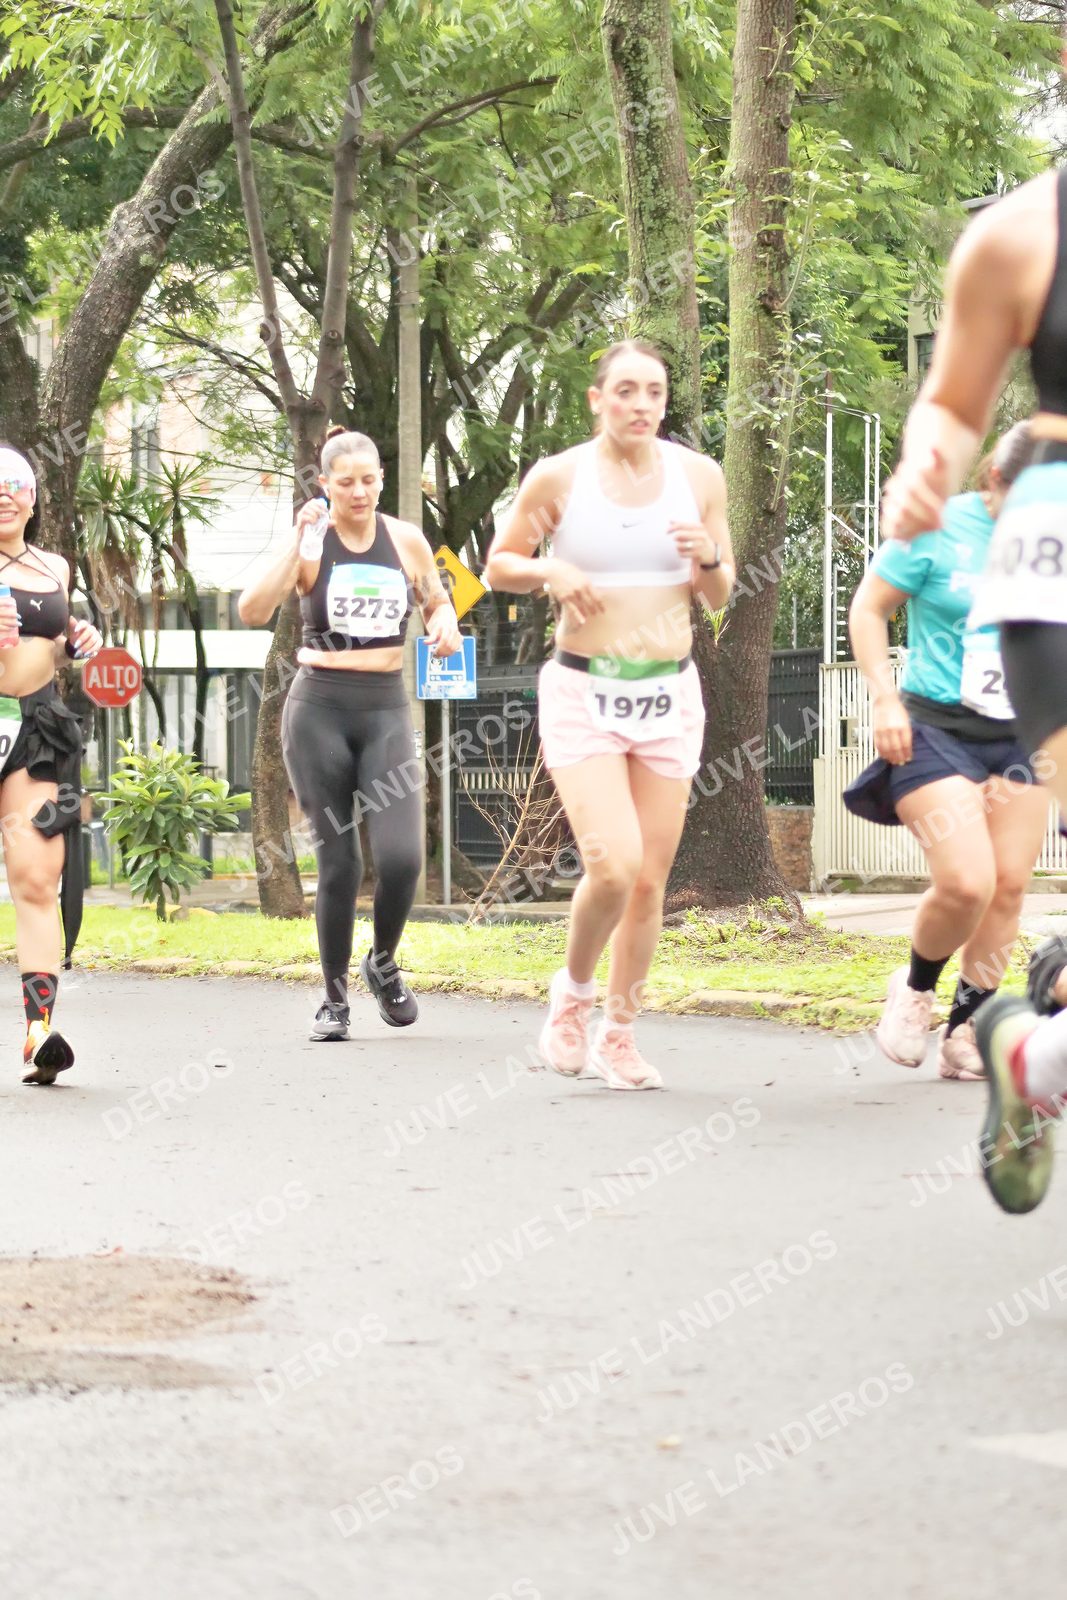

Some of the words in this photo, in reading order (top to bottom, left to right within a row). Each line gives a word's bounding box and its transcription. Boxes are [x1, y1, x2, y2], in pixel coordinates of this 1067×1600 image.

[333, 597, 400, 619] 3273
[88, 665, 138, 689] ALTO
[595, 693, 672, 720] 1979
